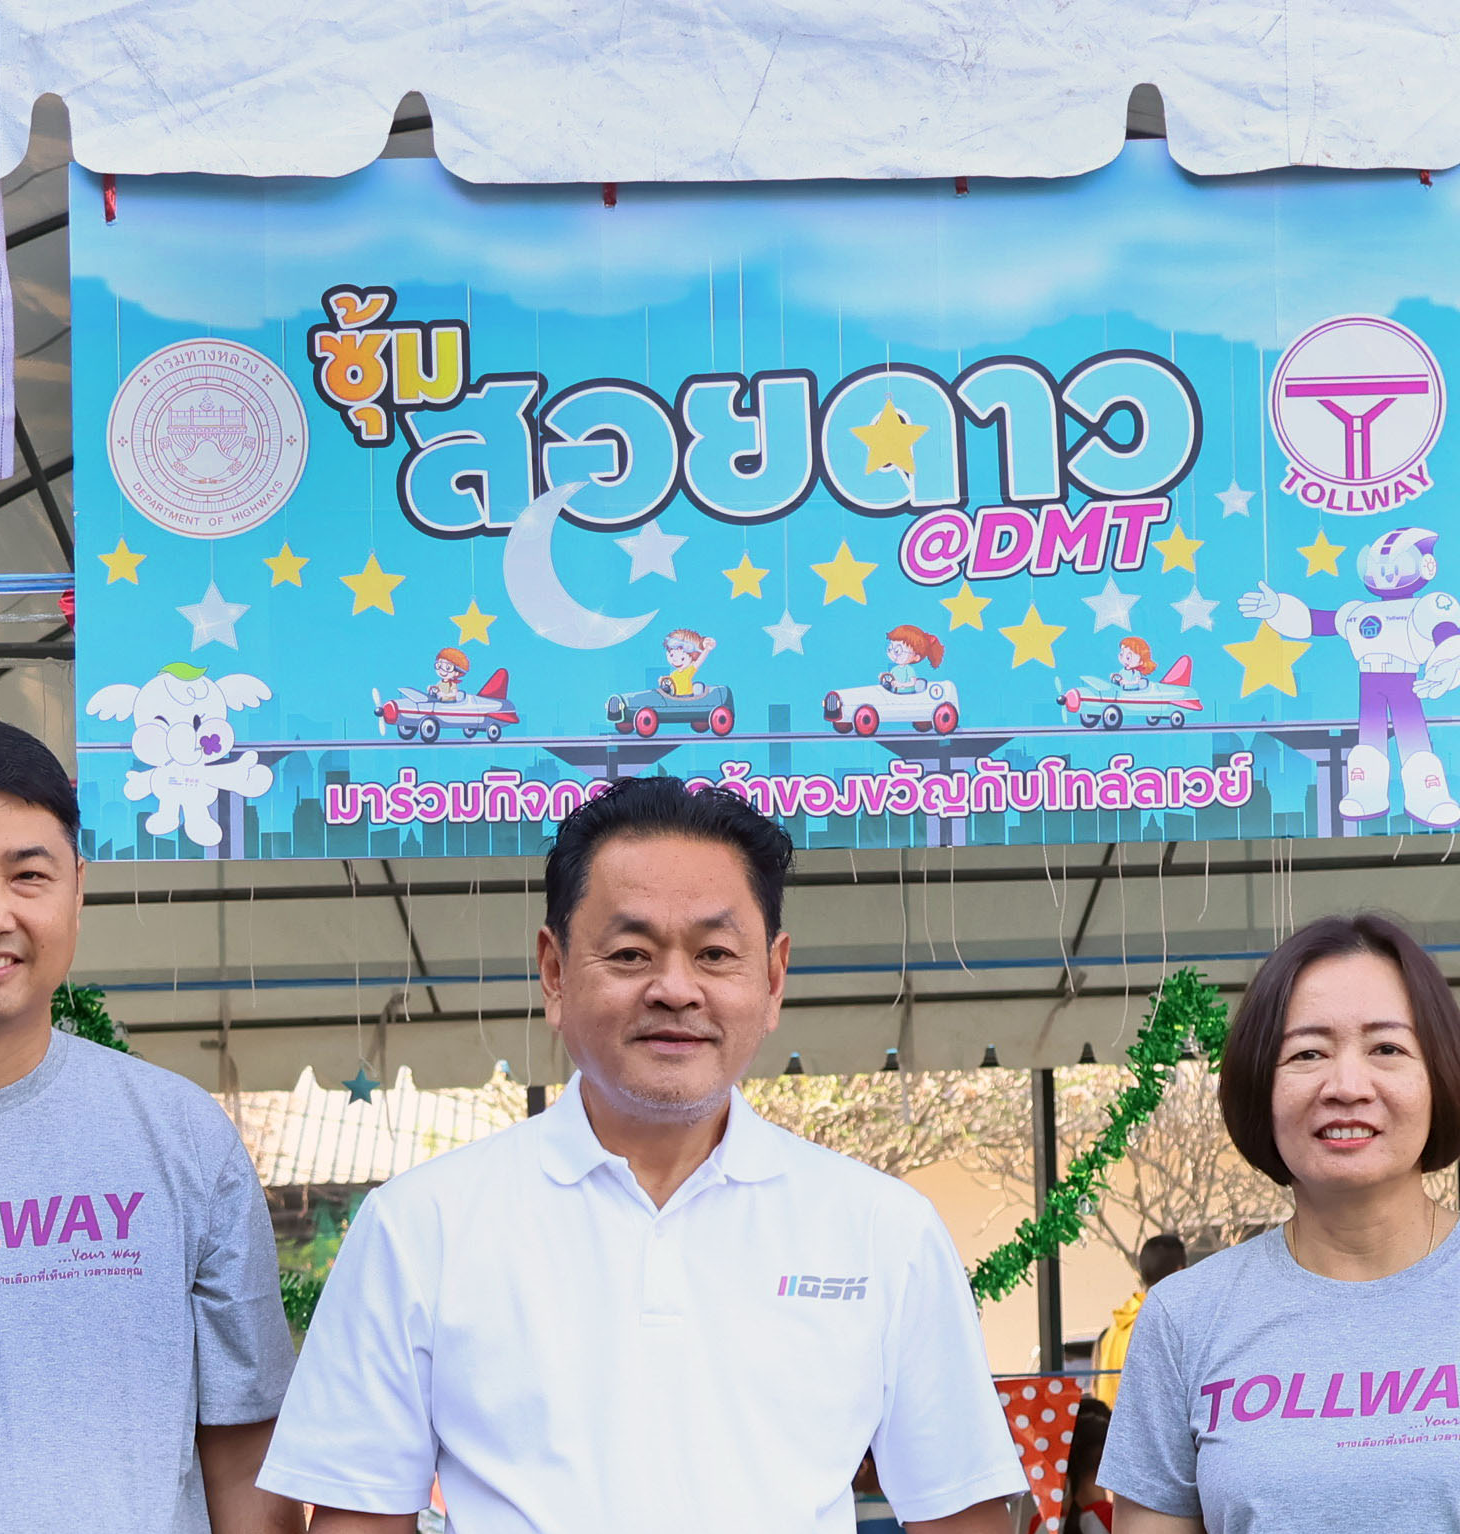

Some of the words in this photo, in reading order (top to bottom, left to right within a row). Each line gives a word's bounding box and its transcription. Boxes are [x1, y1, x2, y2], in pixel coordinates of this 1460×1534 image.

[154, 349, 259, 376] กรมทางหลวง
[310, 287, 468, 446] ซุ้ม
[400, 350, 1201, 538] สอยดาว
[132, 481, 200, 526] DEPARTMENT
[208, 517, 225, 527] OF
[231, 480, 284, 523] HIGHWAYS
[1285, 464, 1431, 512] TOLLWAY
[901, 497, 1169, 582] @DMT
